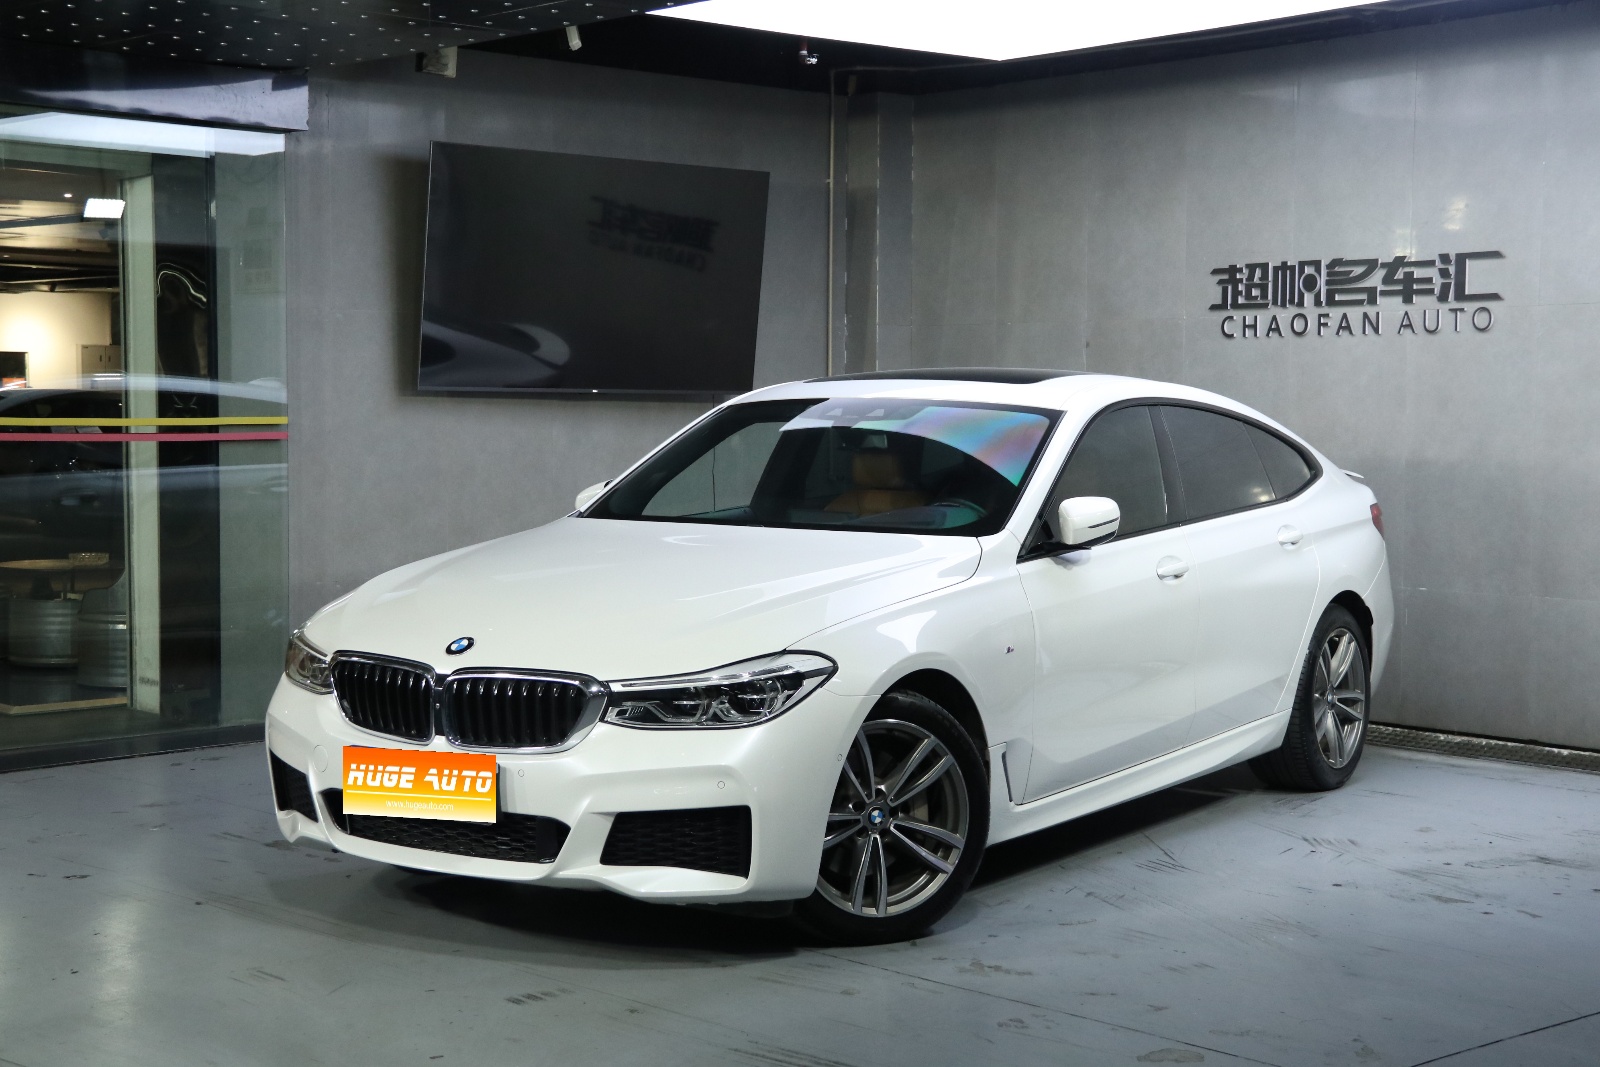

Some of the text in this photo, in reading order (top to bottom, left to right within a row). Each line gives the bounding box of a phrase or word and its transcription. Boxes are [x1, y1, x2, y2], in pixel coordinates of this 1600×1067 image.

[1208, 250, 1506, 311] 超帆名车汇
[1220, 306, 1494, 338] CHAOFAN AUTO
